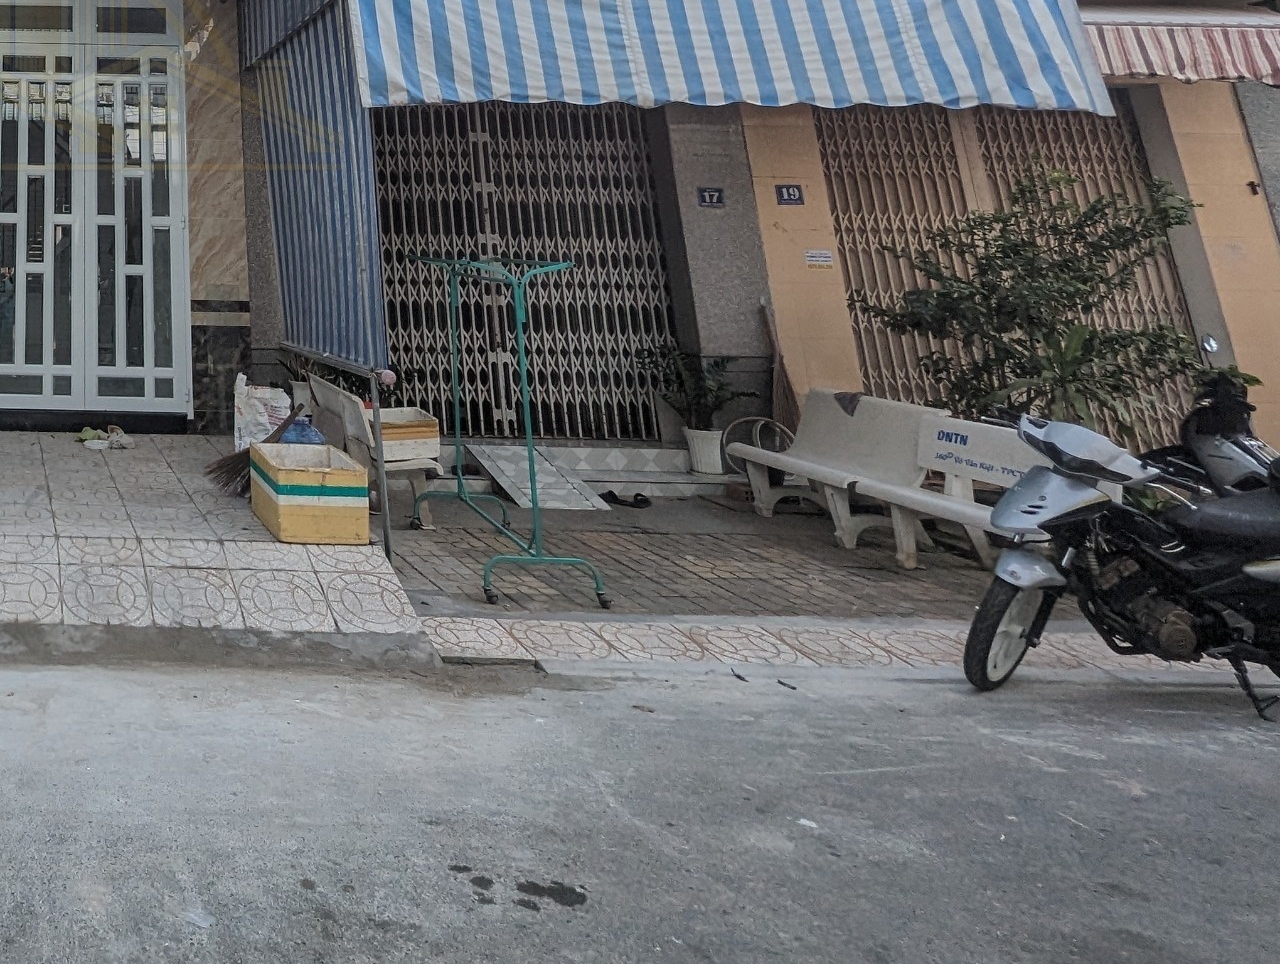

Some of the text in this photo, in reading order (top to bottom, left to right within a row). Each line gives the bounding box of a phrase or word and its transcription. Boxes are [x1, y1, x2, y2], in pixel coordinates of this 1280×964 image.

[702, 192, 719, 203] 17
[781, 187, 800, 200] 19
[937, 430, 969, 446] DNTN
